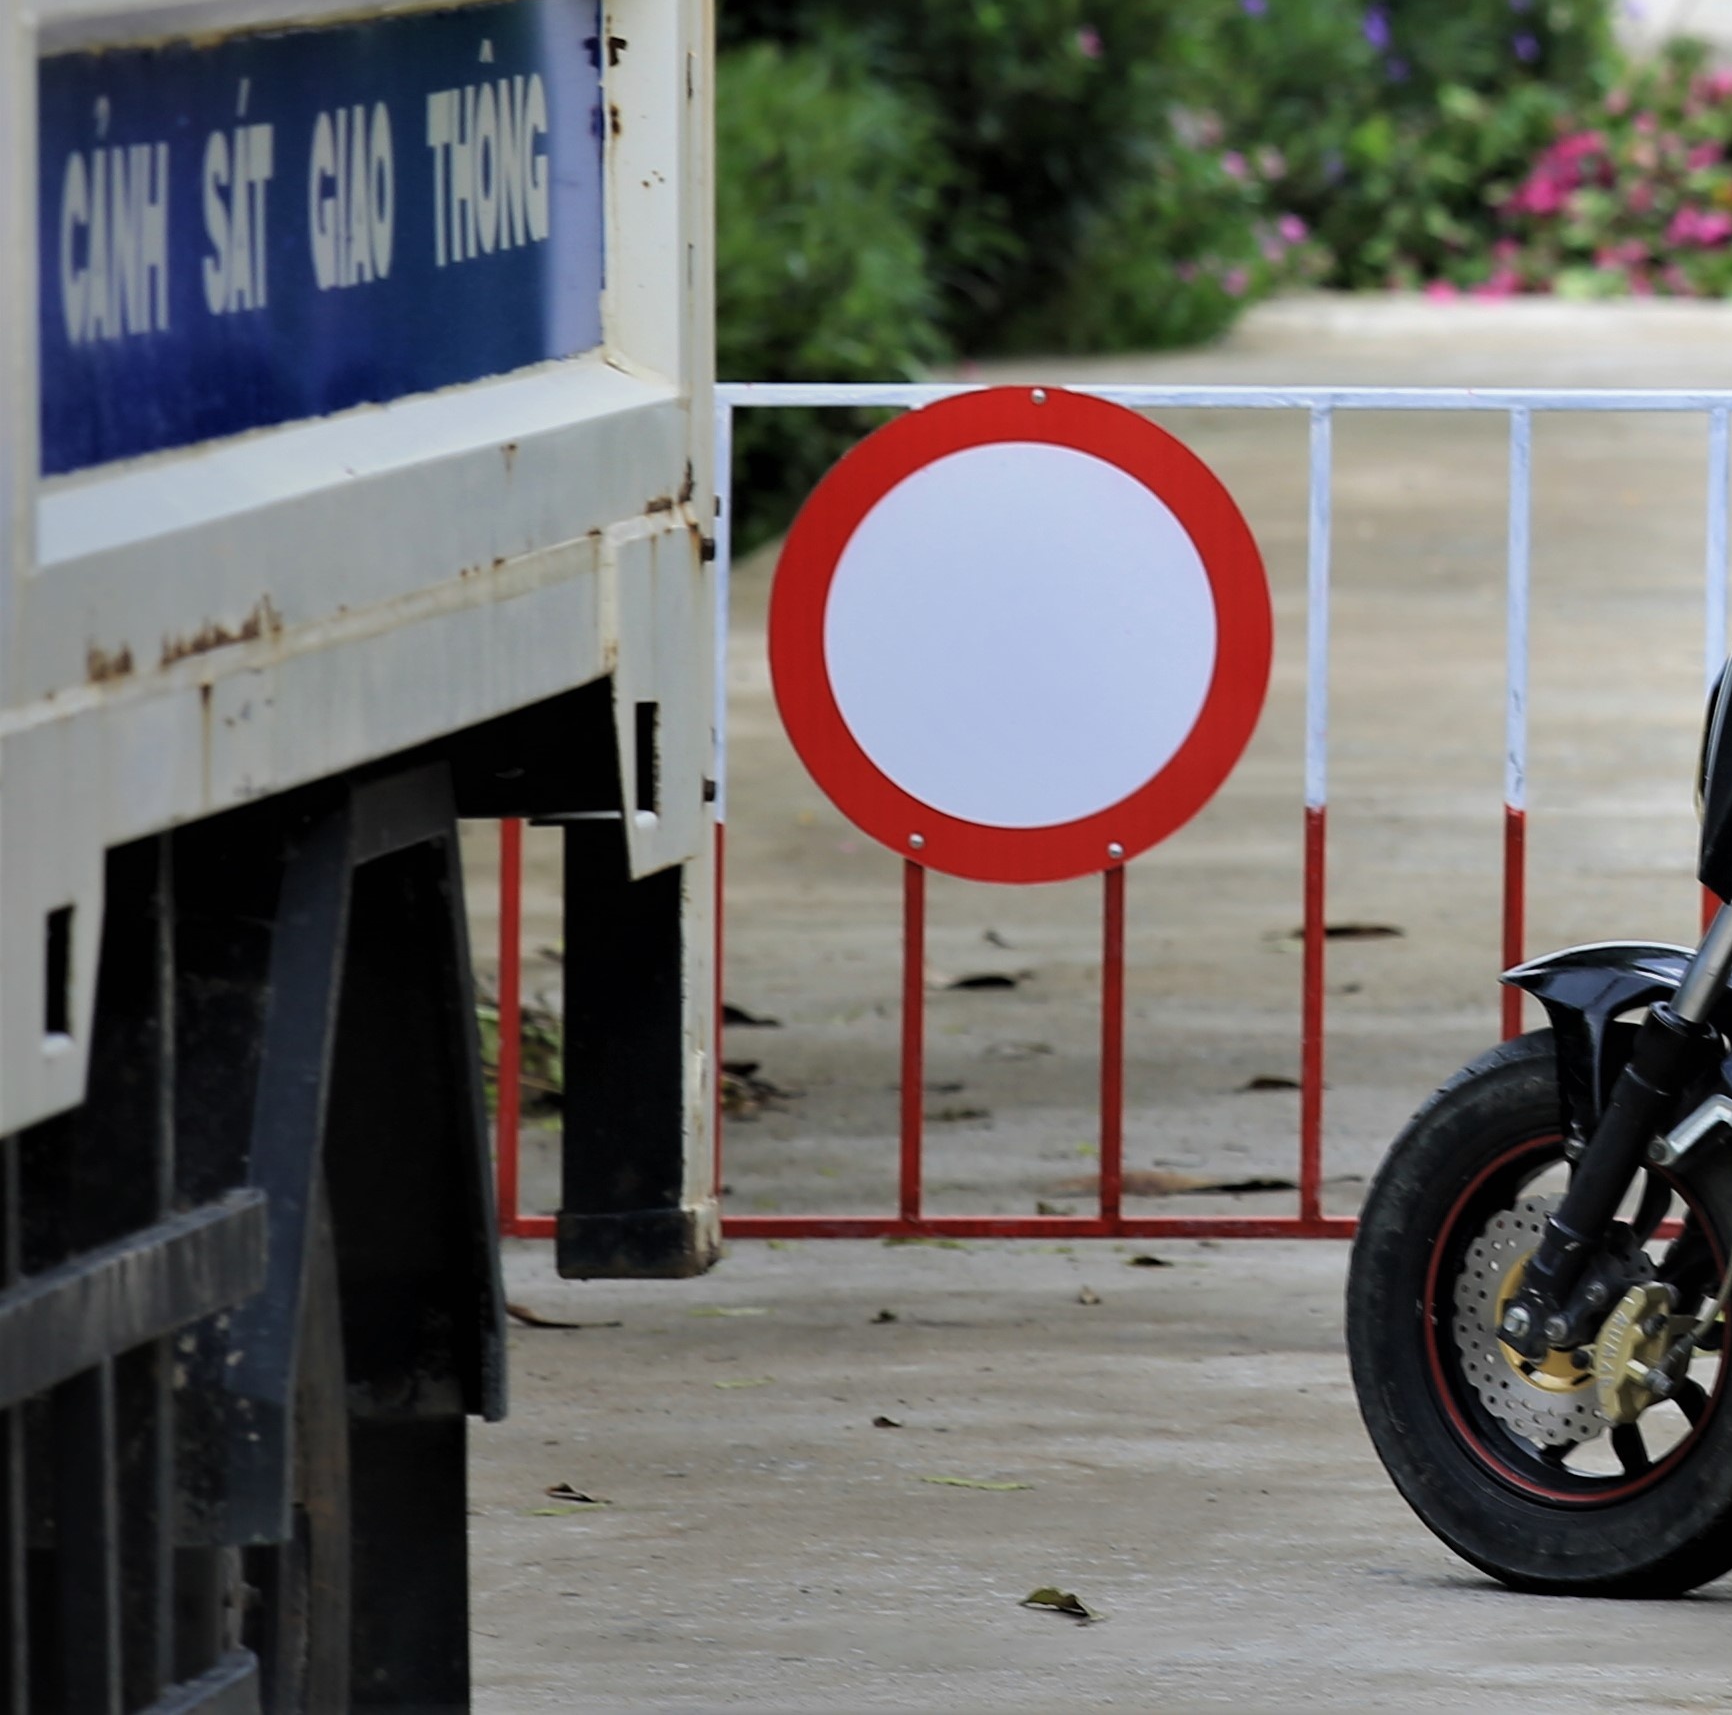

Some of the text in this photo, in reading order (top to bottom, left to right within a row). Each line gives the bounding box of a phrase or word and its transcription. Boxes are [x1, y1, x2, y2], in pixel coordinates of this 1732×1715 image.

[61, 39, 550, 343] CẢNH SÁT GIAO THÔNG
